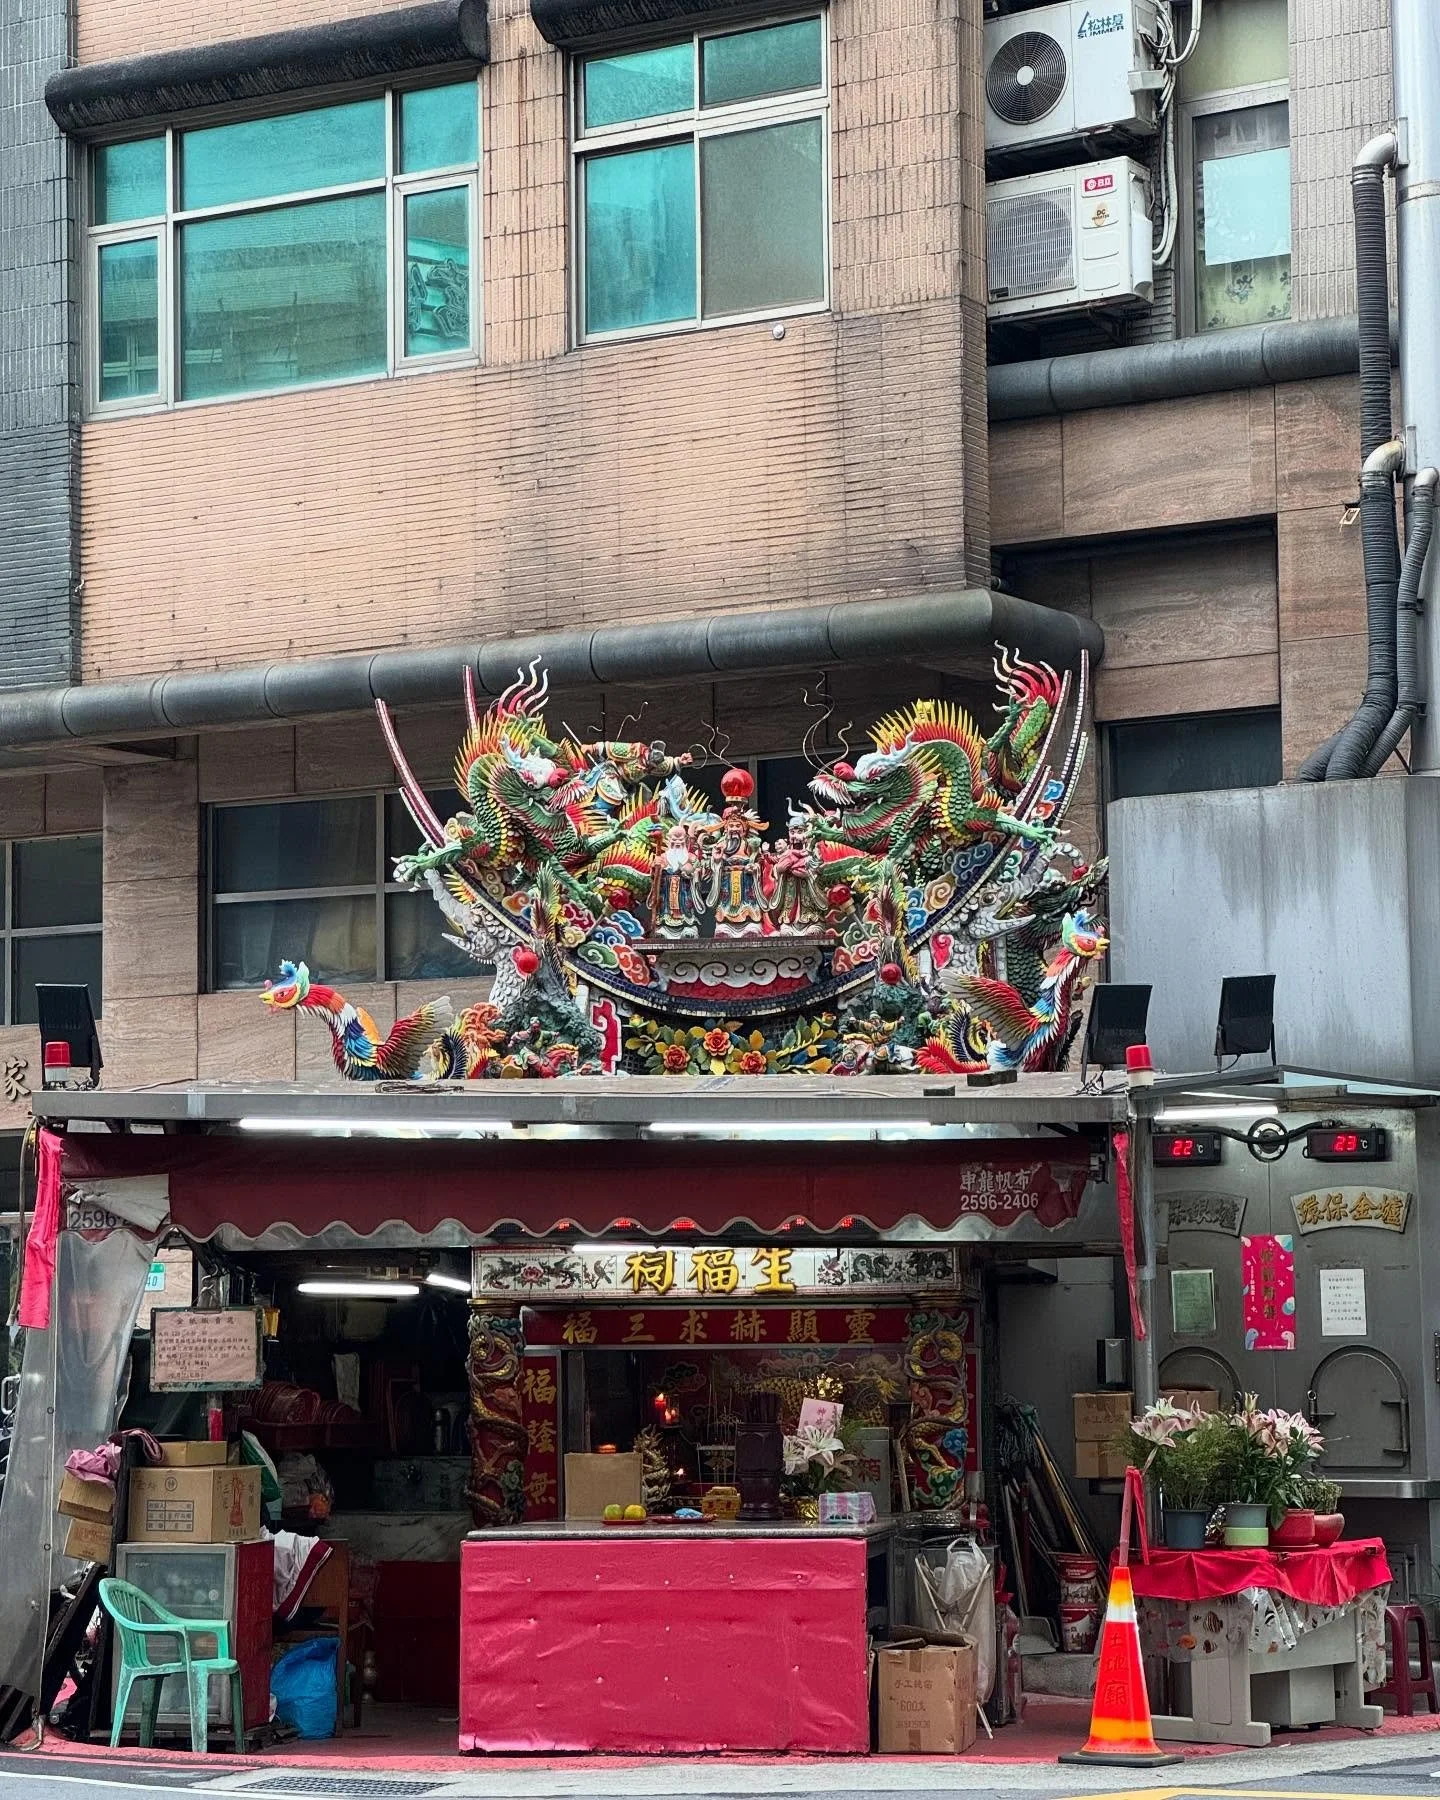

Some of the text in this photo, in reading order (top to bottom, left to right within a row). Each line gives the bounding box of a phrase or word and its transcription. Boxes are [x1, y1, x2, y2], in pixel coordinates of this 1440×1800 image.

[1078, 25, 1124, 39] SUMMER
[1096, 208, 1106, 216] DC
[3, 1055, 31, 1102] 家
[1172, 1139, 1194, 1157] 22
[1334, 1135, 1358, 1152] 23
[961, 1193, 1039, 1211] 2596-2406
[1296, 1190, 1404, 1227] 環保金爐
[1103, 1632, 1130, 1705] 土地廟
